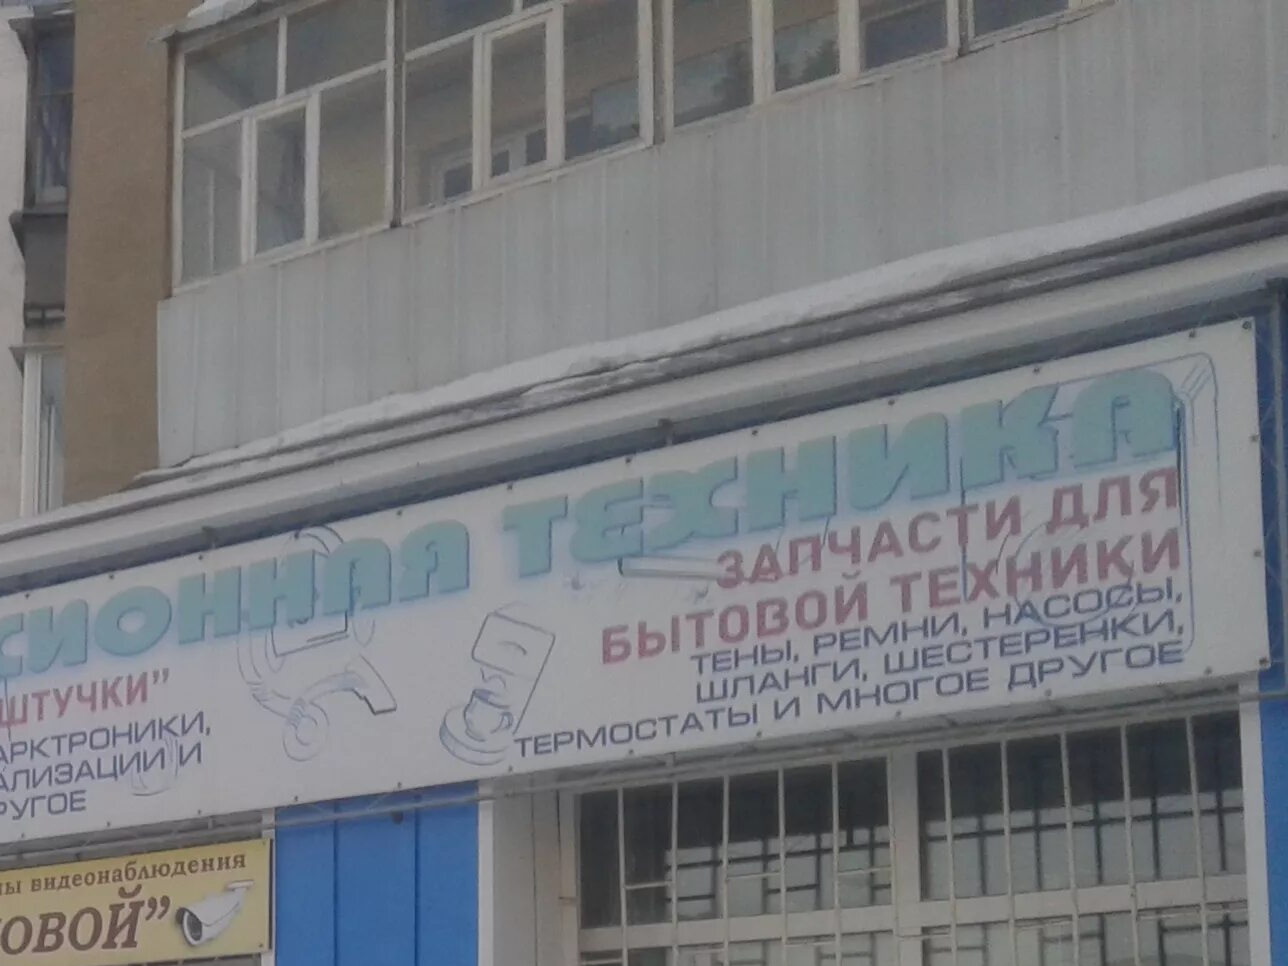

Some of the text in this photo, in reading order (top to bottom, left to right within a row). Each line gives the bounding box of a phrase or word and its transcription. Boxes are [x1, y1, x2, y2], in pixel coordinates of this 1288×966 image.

[503, 368, 1180, 580] ТЕХНИКА
[715, 467, 1178, 591] ЗАПЧАСТИ ДЛЯ
[601, 528, 1181, 665] БЫТОВОЙ ТЕХНИКИ
[691, 577, 1183, 677] ТЕНЫ, РЕМНИ, НАСОСЫ,
[514, 639, 1185, 759] ТЕРМОСТАТЫ И МНОГОЕ ДРУГОЕ
[696, 608, 1185, 706] ШЛАНГИ, ШЕСТЕРЕНКИ,
[178, 740, 202, 766] И
[31, 853, 246, 892] видеонаблюдения
